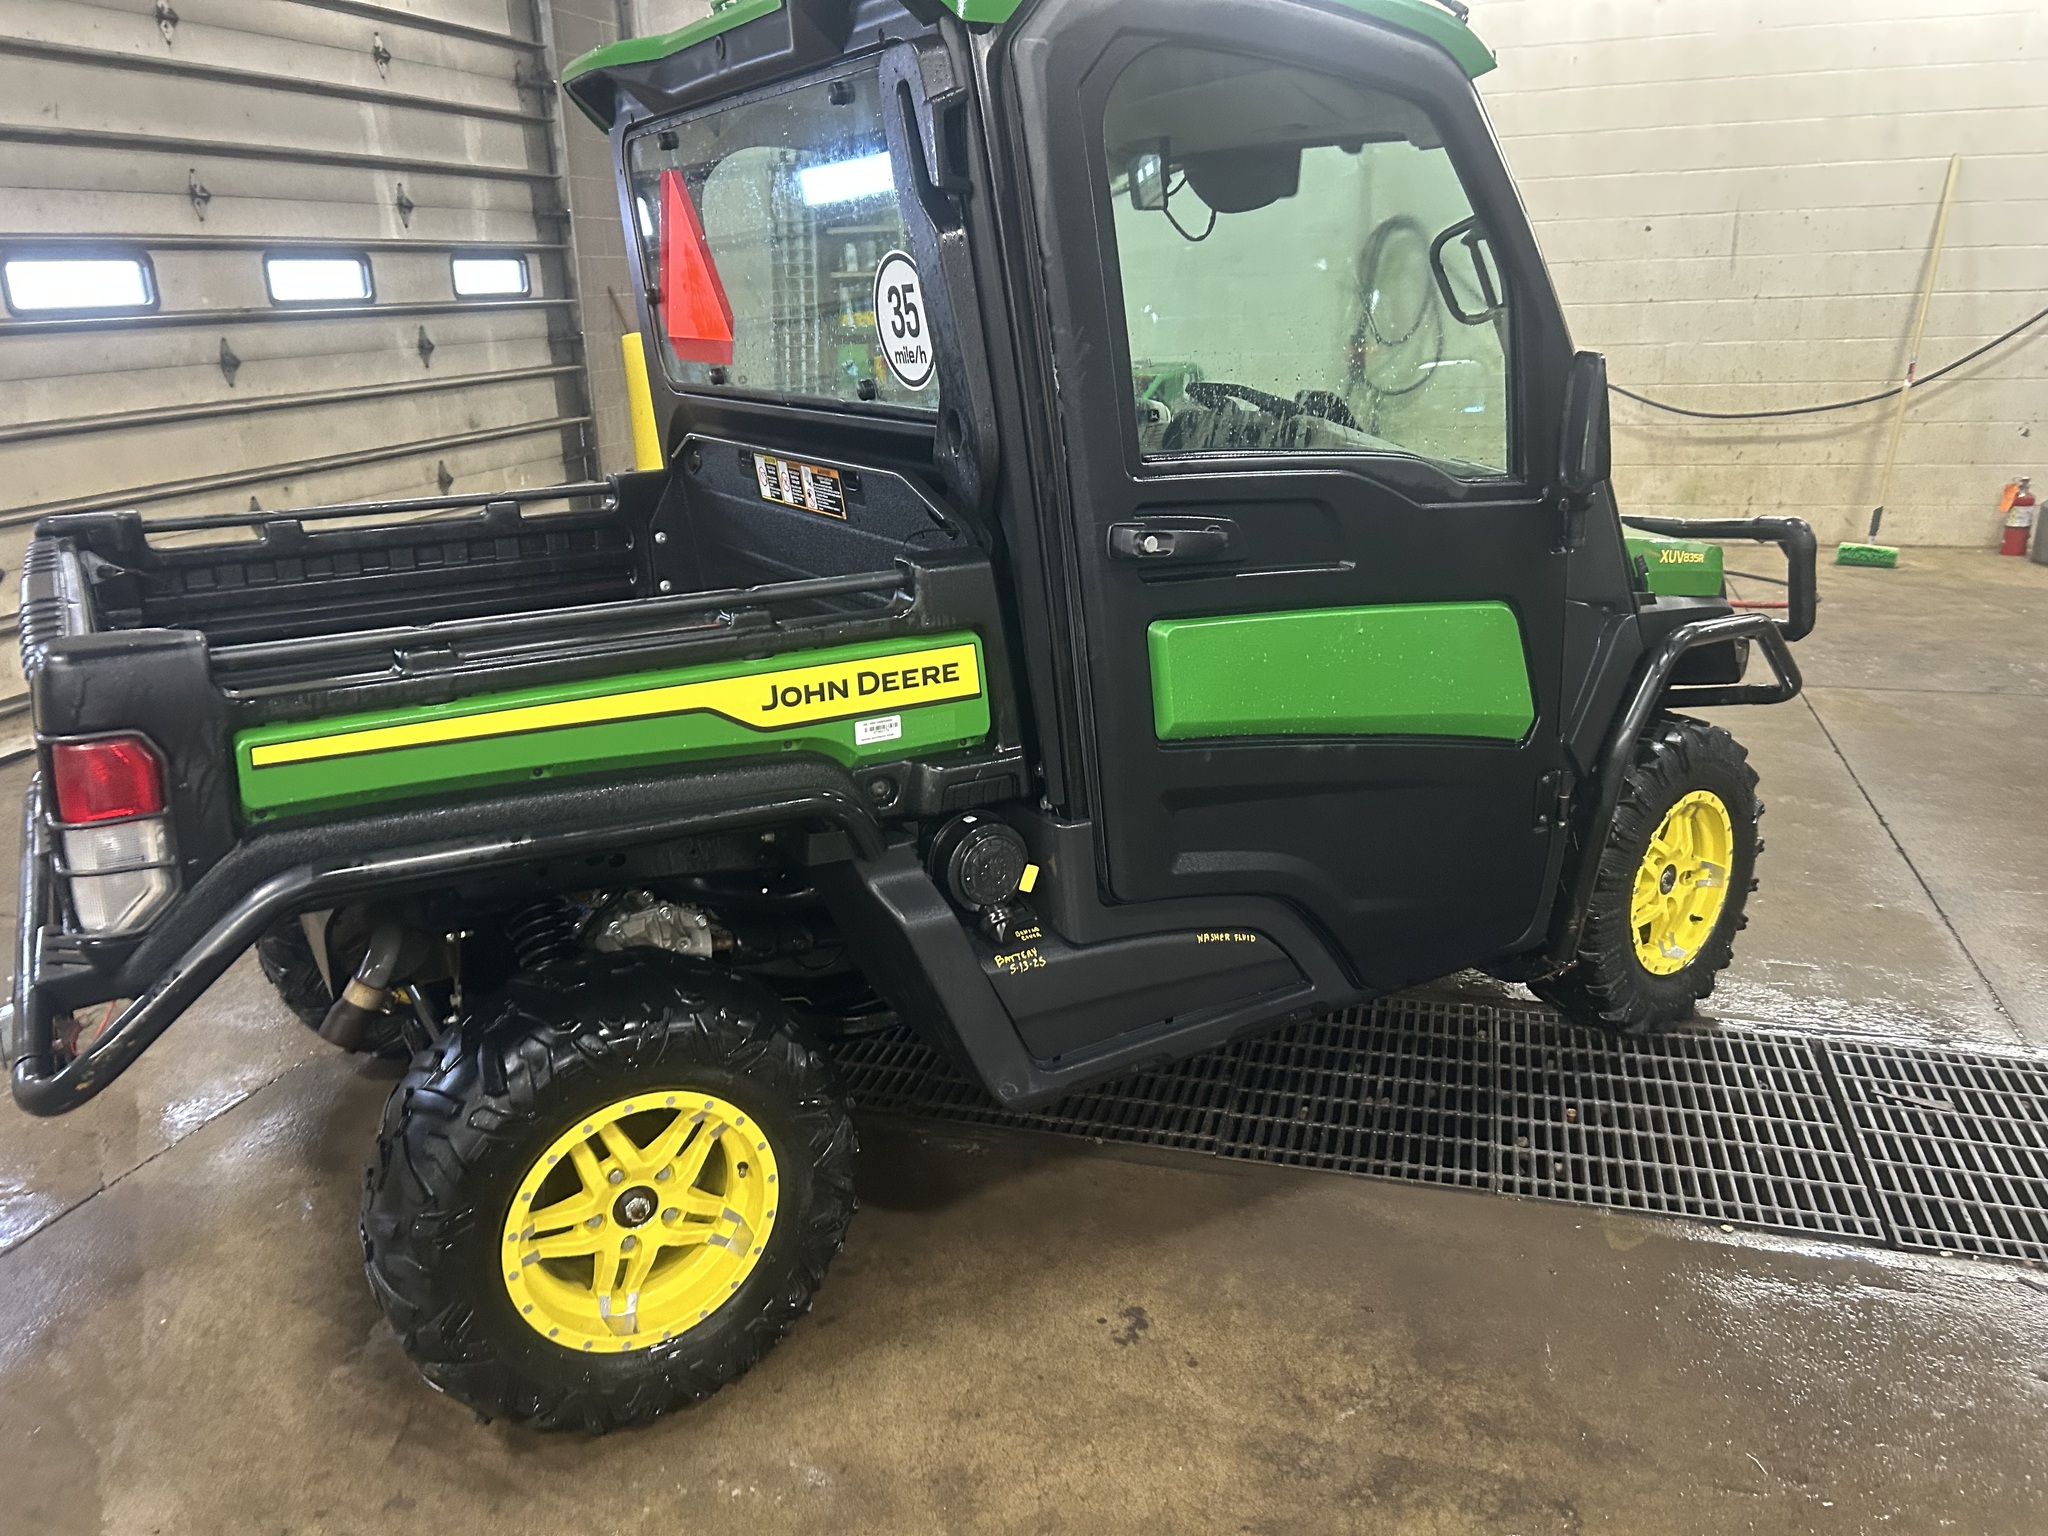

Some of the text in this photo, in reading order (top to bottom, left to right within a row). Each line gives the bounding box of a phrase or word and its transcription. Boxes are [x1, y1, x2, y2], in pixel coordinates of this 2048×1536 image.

[887, 284, 920, 338] 35
[894, 345, 928, 364] mile/h
[761, 662, 960, 711] JOHN DEERE
[1196, 933, 1256, 943] WASHER FLUID
[994, 947, 1038, 968] BATTERY
